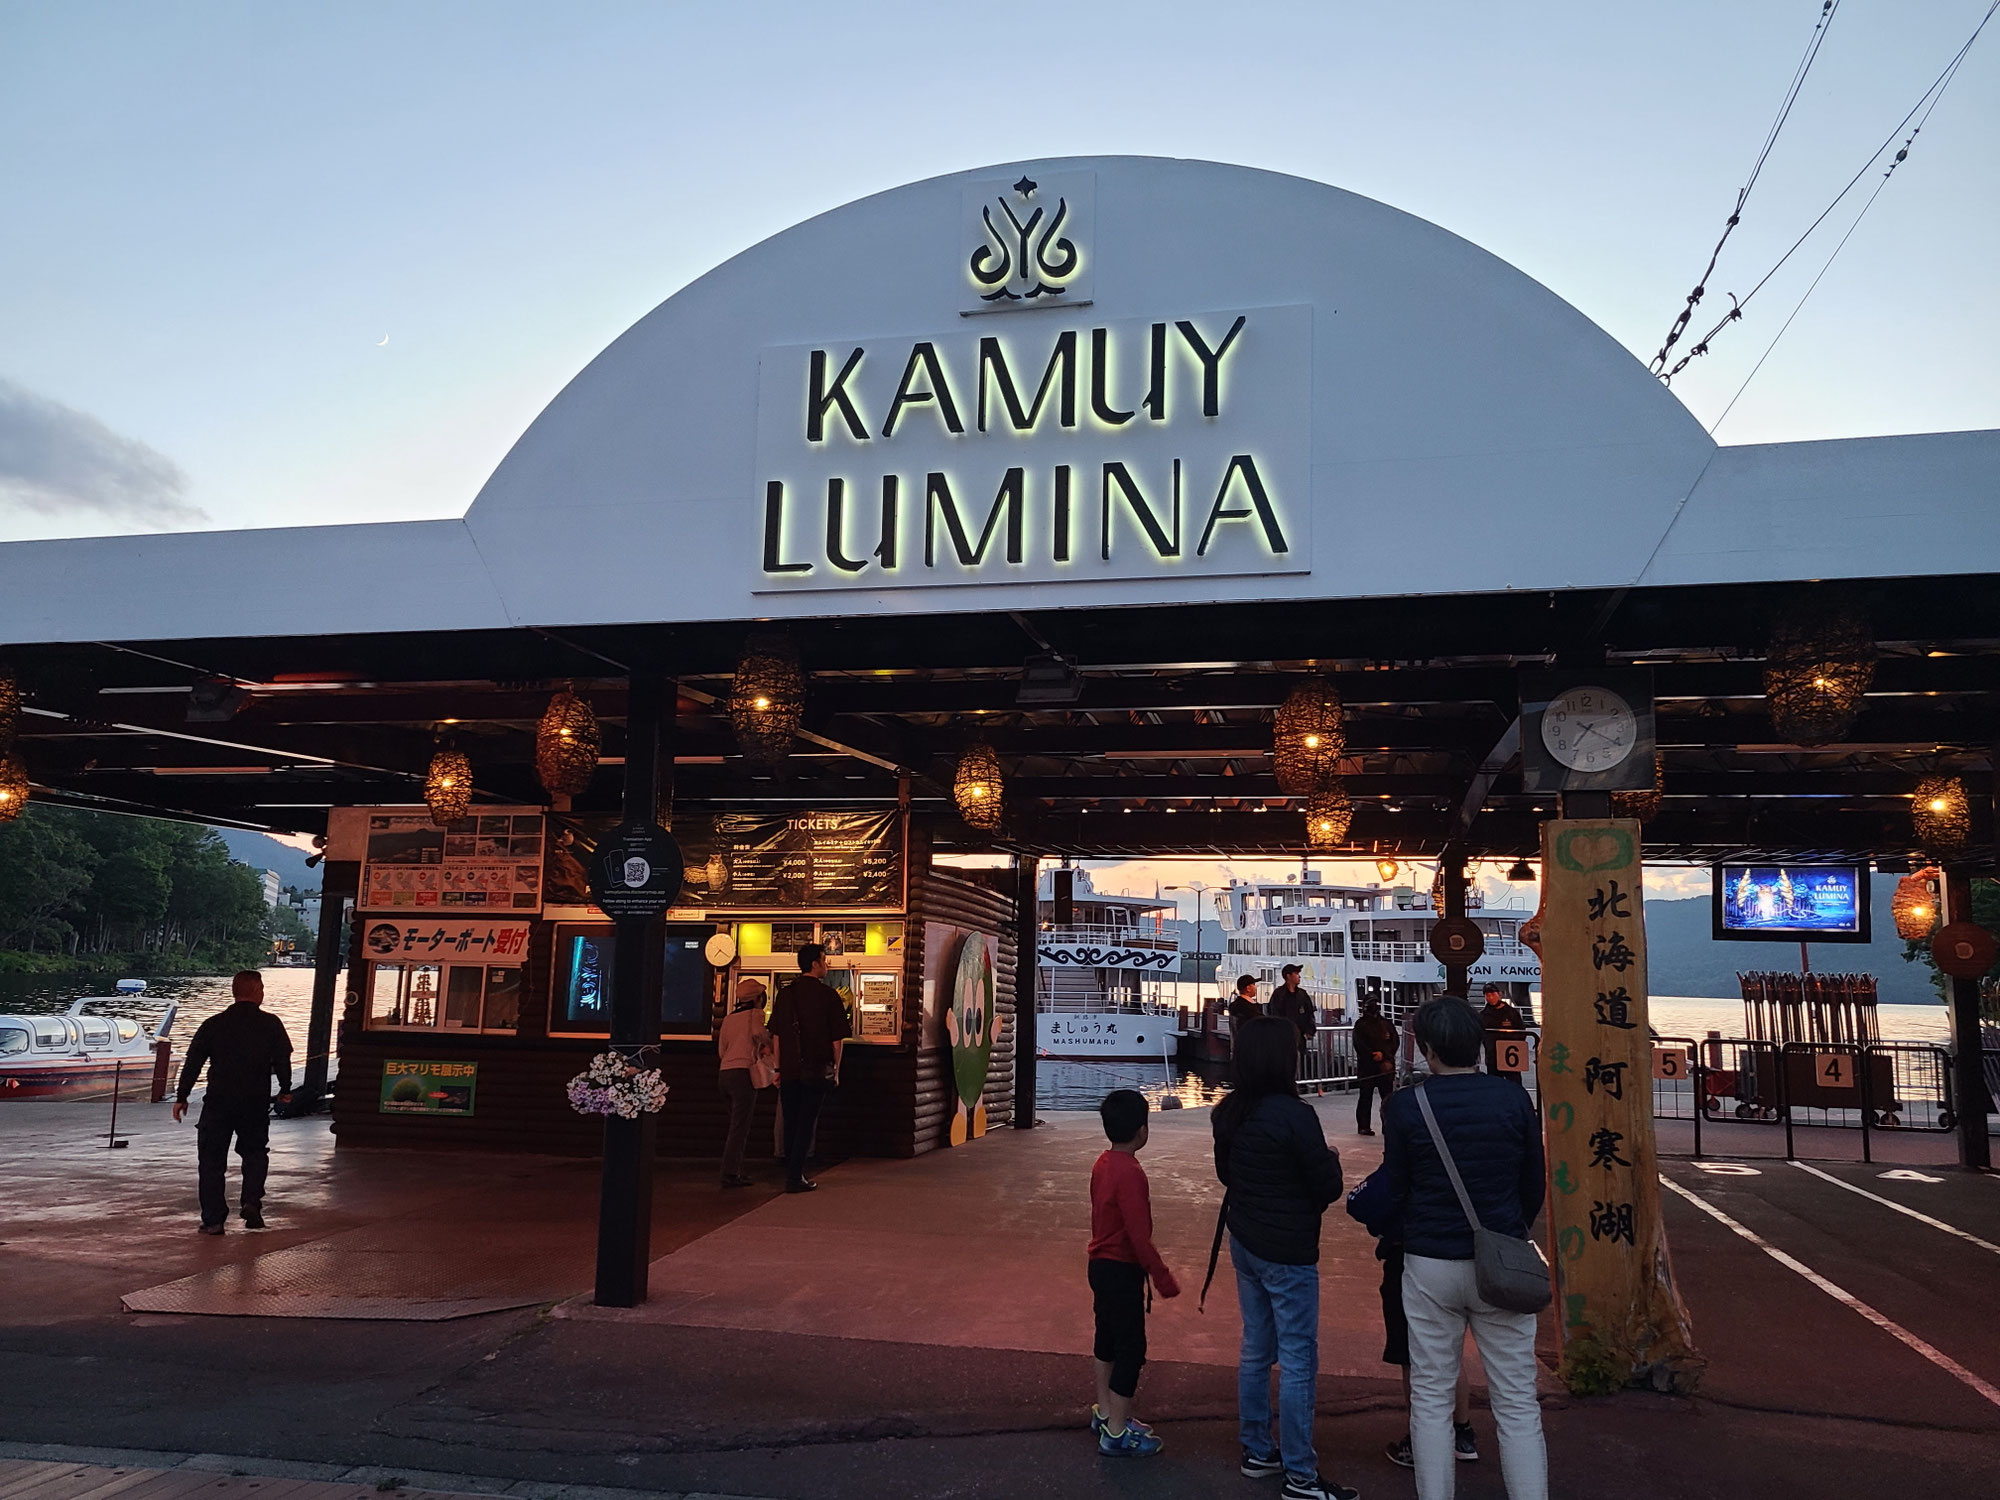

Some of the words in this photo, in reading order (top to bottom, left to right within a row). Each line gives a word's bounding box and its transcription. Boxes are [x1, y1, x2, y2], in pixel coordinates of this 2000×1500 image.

[806, 315, 1246, 442] KAMUY
[763, 455, 1289, 573] LUMINA
[787, 818, 838, 830] TICKETS
[862, 858, 887, 866] ¥5,200
[782, 872, 806, 880] ¥2,000
[862, 871, 888, 879] ¥2,400
[1815, 884, 1848, 892] KAMUY
[1813, 892, 1850, 900] LUMINA
[403, 927, 527, 955] モーターボート受付
[1050, 1021, 1118, 1035] ましゅう丸
[1053, 1038, 1116, 1046] MASHUMARU
[1504, 1045, 1520, 1068] 6
[1585, 880, 1638, 1246] 北海道阿寒湖
[385, 1062, 475, 1078] 巨大マリモ展示中
[1661, 1052, 1678, 1077] 5
[1824, 1058, 1842, 1082] 4
